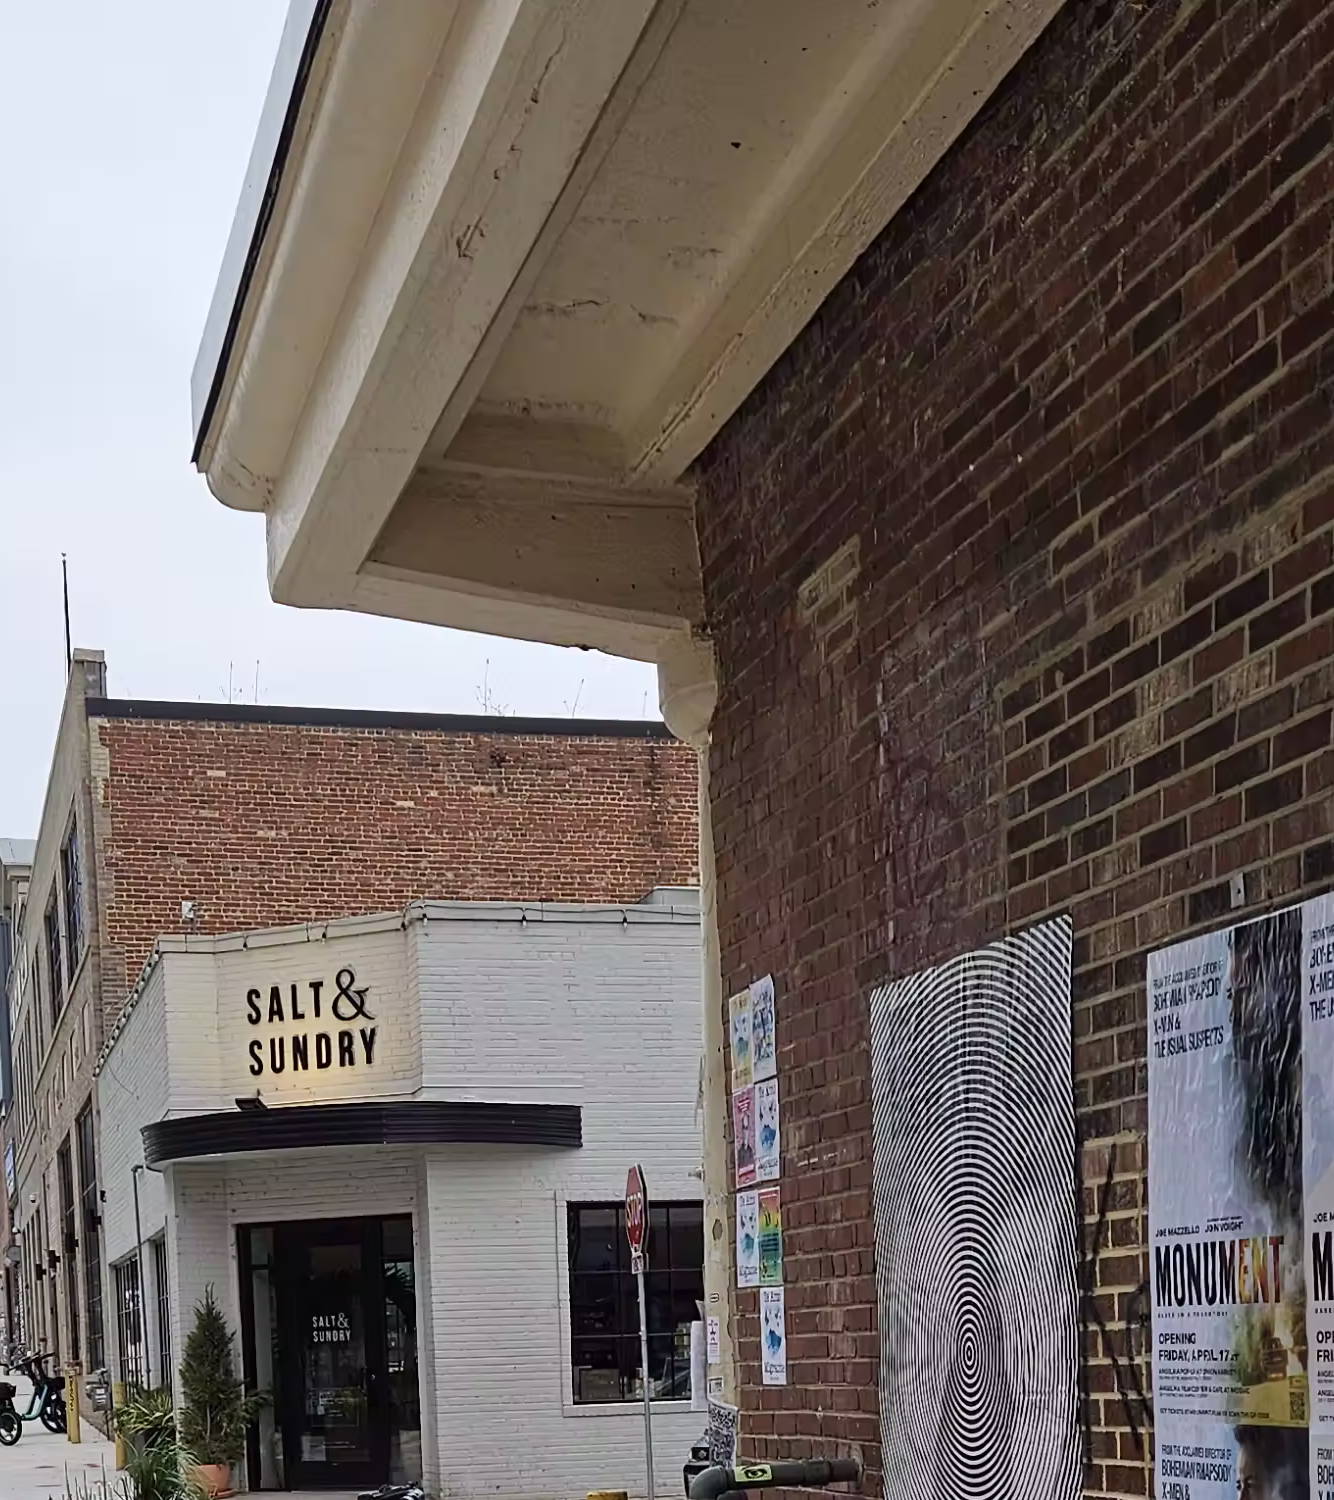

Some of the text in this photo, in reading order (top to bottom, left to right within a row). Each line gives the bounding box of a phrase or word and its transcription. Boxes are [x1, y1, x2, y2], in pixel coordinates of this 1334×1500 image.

[247, 968, 375, 1025] SALT &
[248, 1026, 377, 1077] SUNDRY
[627, 1192, 643, 1228] STOP
[1154, 1235, 1284, 1308] MONUMENT
[312, 1312, 349, 1328] SALT &
[313, 1330, 351, 1342] SUNDRY
[1218, 1348, 1230, 1362] 17
